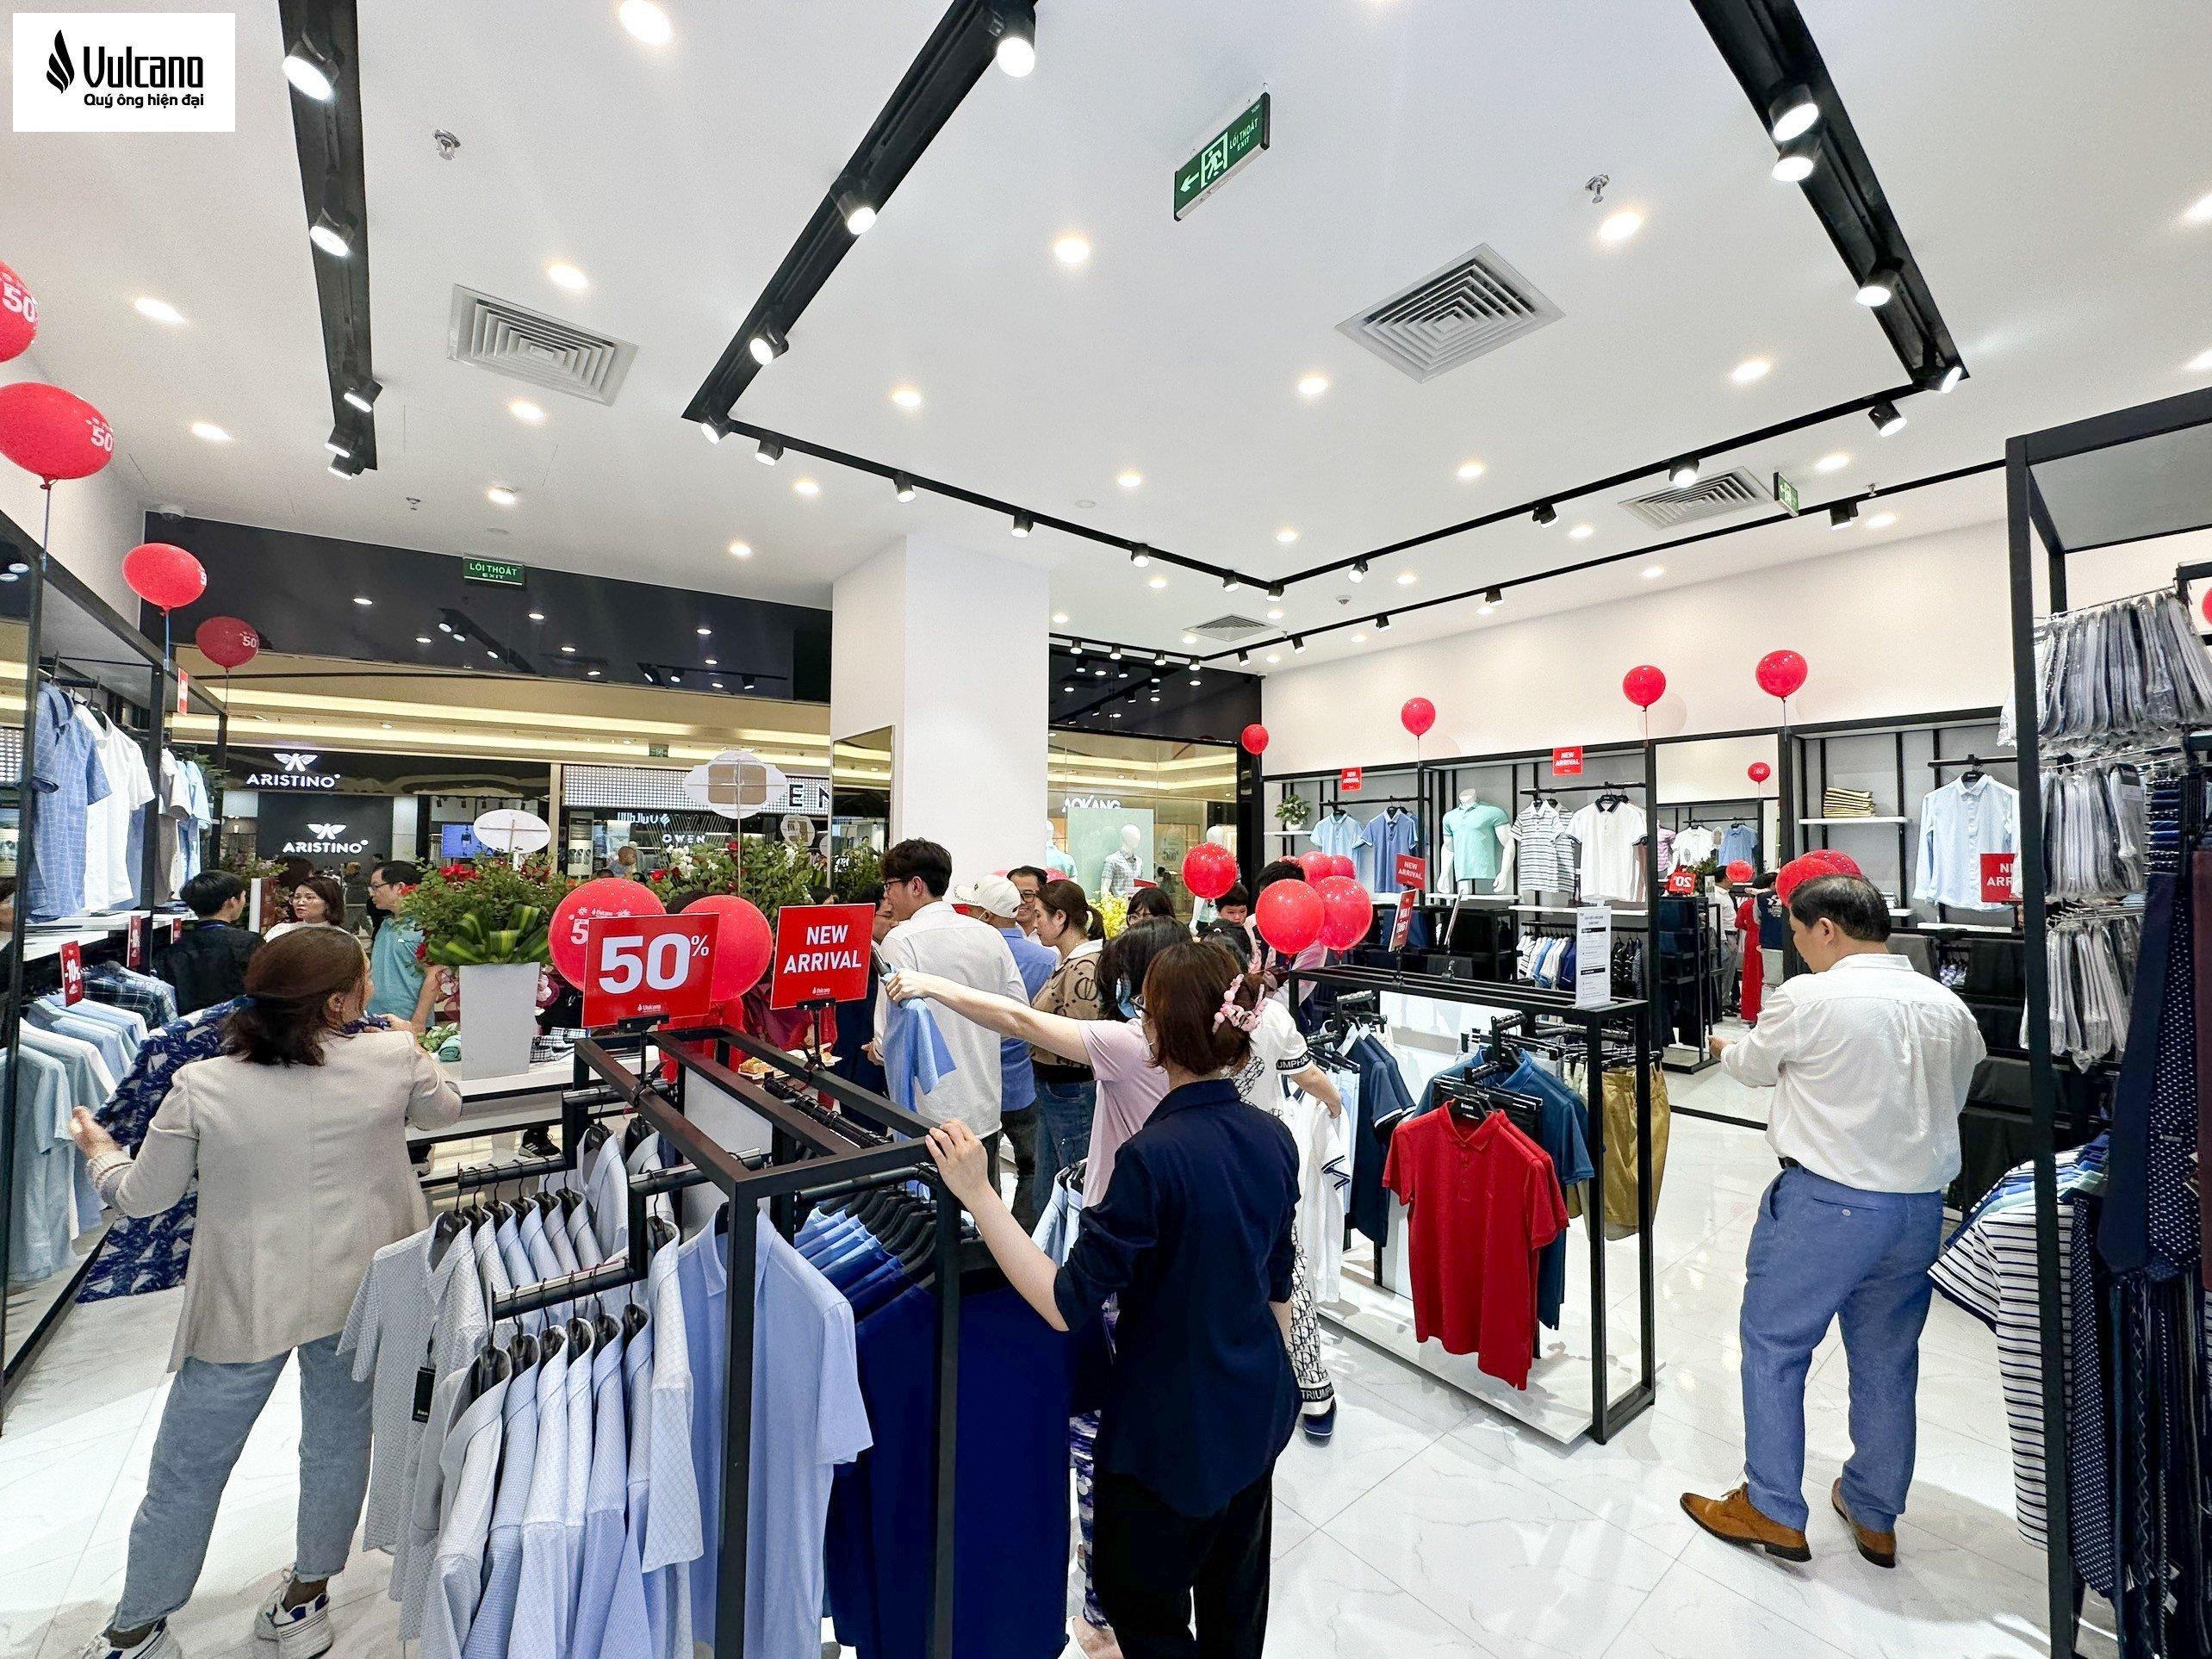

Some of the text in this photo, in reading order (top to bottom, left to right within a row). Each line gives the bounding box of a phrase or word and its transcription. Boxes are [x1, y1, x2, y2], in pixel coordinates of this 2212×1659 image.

[1230, 118, 1258, 149] LỐI THOÁT
[1237, 135, 1250, 152] EXIT
[469, 562, 517, 576] LỐI THOÁT
[245, 774, 335, 788] ARISTINO
[662, 833, 705, 844] OWEN
[282, 842, 363, 854] ARISTINO
[1404, 861, 1418, 870] NEW
[1398, 868, 1423, 880] ARRIVAL
[805, 924, 849, 946] NEW
[598, 933, 710, 995] 50%
[783, 950, 862, 974] ARRIVAL
